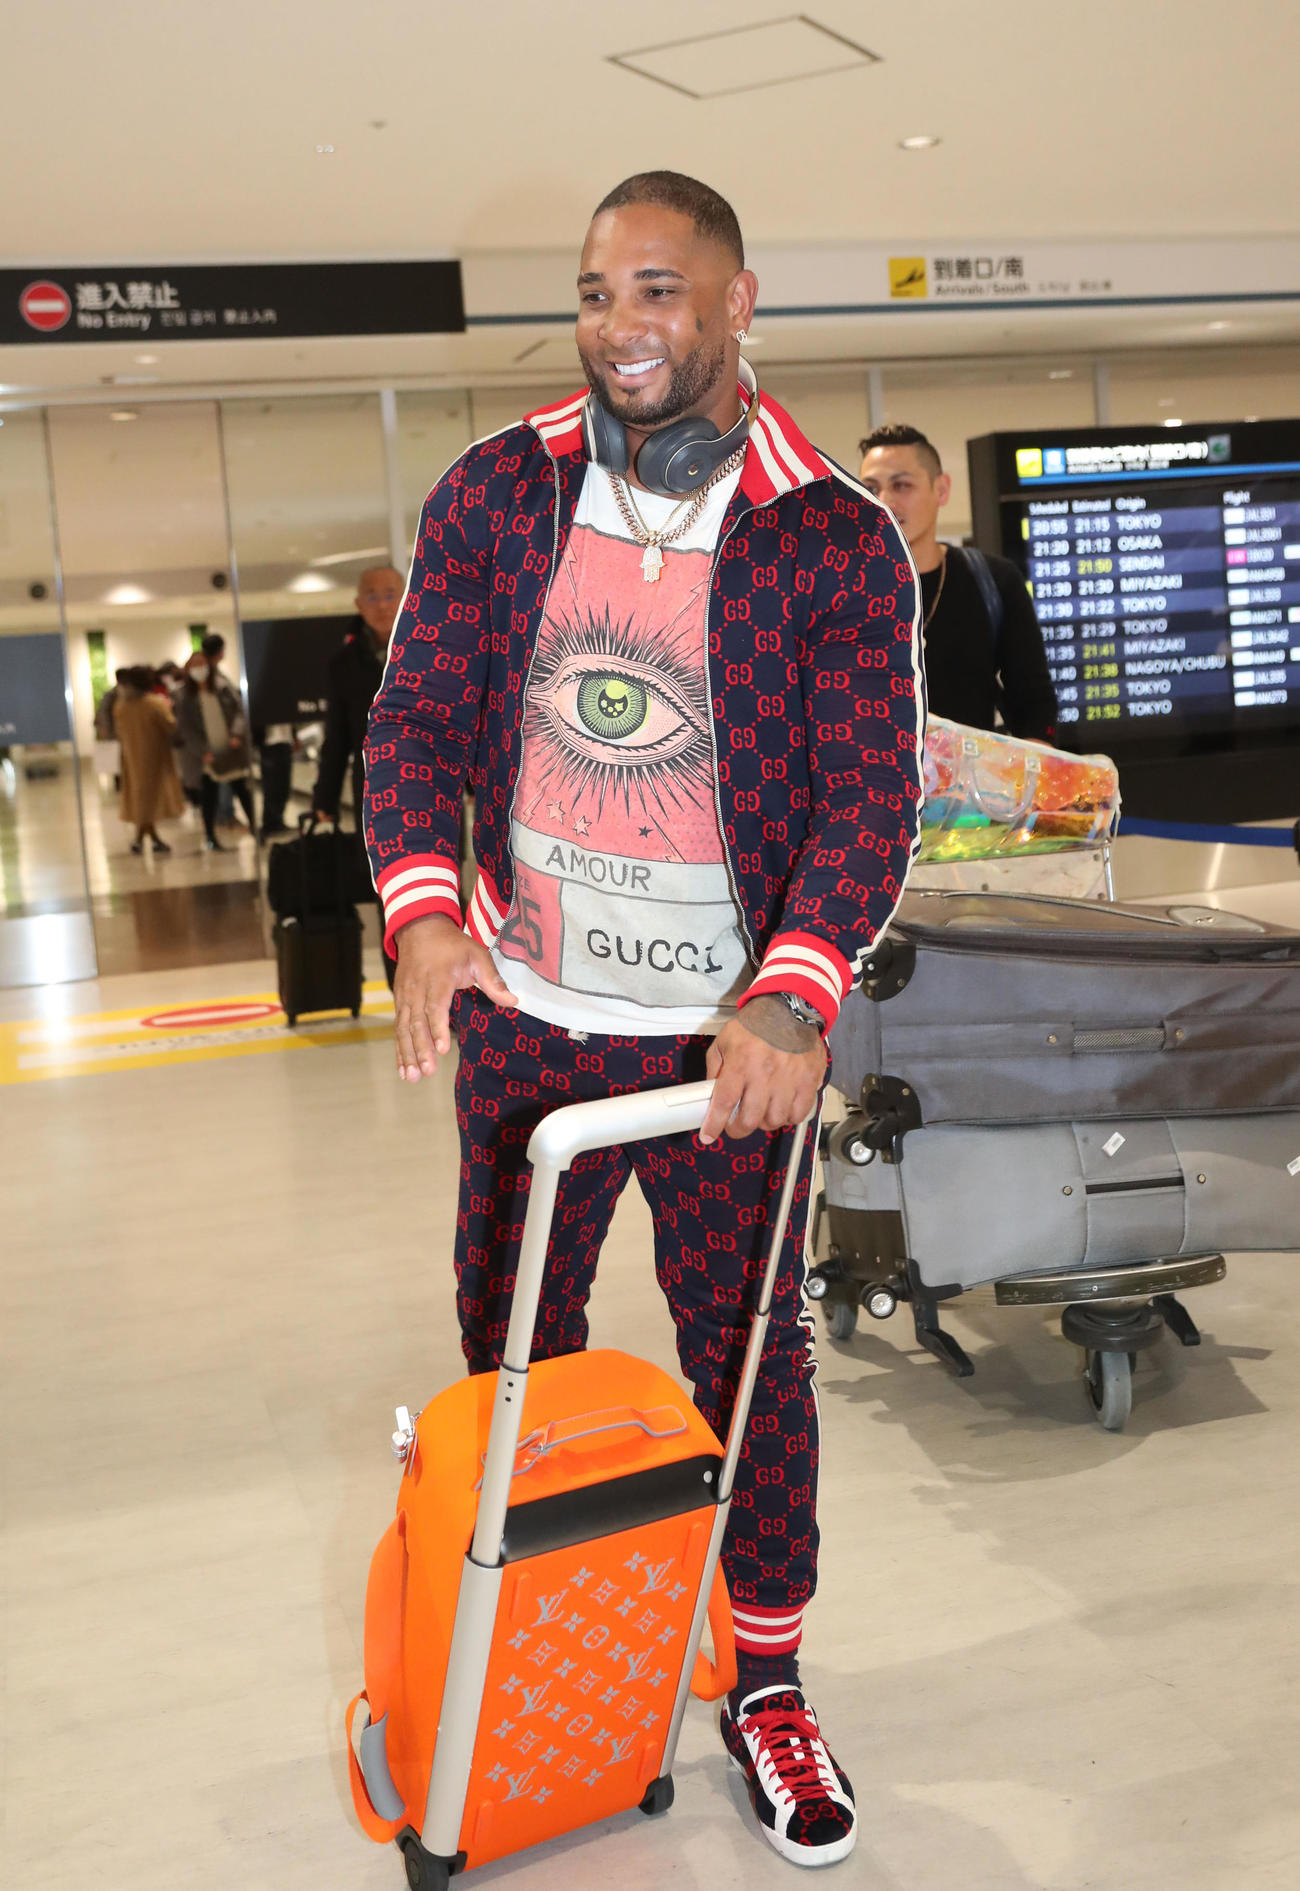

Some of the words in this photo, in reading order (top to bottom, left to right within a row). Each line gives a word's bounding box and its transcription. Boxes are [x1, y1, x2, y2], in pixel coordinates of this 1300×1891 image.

[76, 281, 180, 310] 進入禁止
[77, 312, 103, 329] No
[106, 311, 152, 331] Entry
[1116, 513, 1162, 530] TOKYO
[1118, 535, 1163, 552] OSAKA
[1119, 555, 1165, 572] SENDAI
[1120, 574, 1183, 592] MIYAZAKI
[1079, 599, 1115, 616] 21:22
[1121, 596, 1168, 613] TOKYO
[1122, 618, 1168, 635] TOKYO
[1045, 645, 1077, 661] 1:35
[1123, 637, 1187, 656] MIYAZAKI
[1049, 667, 1077, 682] 1:40
[1124, 655, 1227, 676] NAGOYA/CHUBU
[1125, 679, 1171, 696] TOKYO
[1127, 699, 1173, 717] TOKYO
[545, 845, 651, 892] AMOUR
[587, 928, 723, 974] GUCCI
